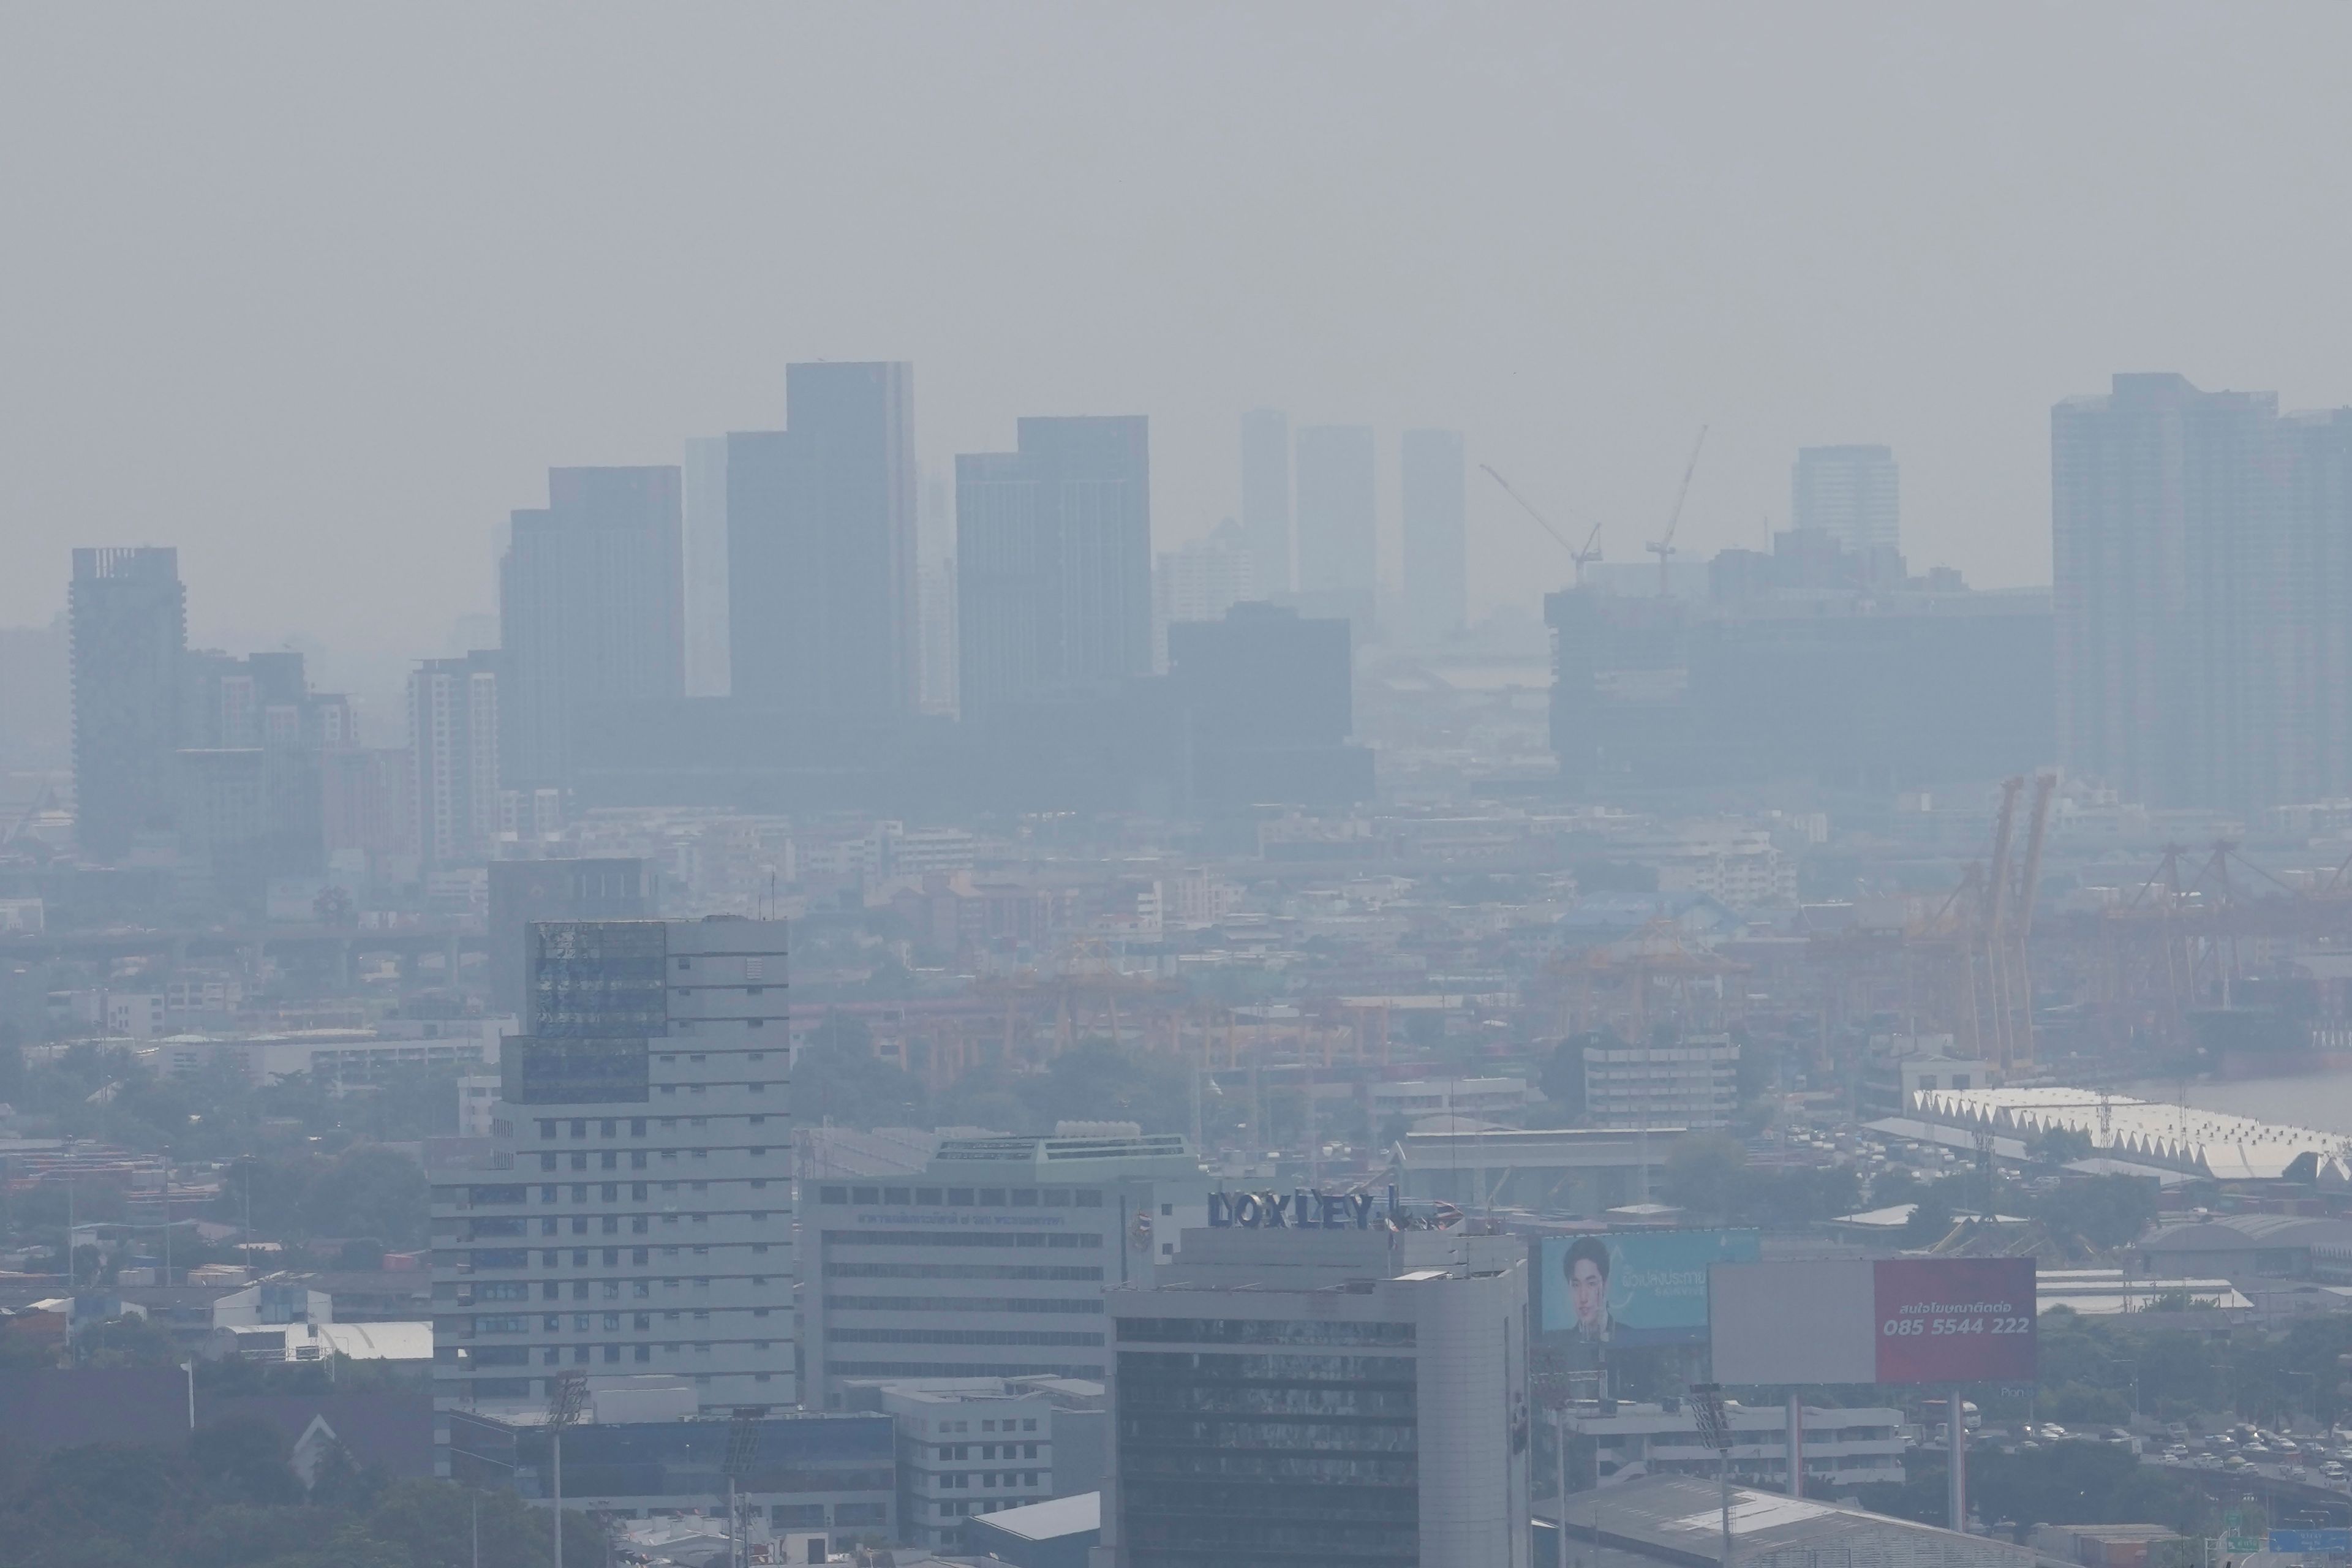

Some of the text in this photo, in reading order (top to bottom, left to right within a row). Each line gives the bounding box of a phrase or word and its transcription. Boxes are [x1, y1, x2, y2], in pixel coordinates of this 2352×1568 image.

[1207, 1189, 1374, 1230] LOXLEY
[1899, 1300, 2012, 1314] สนใจโฆษณาติดต่อ
[1883, 1317, 2029, 1336] 085 5544 222
